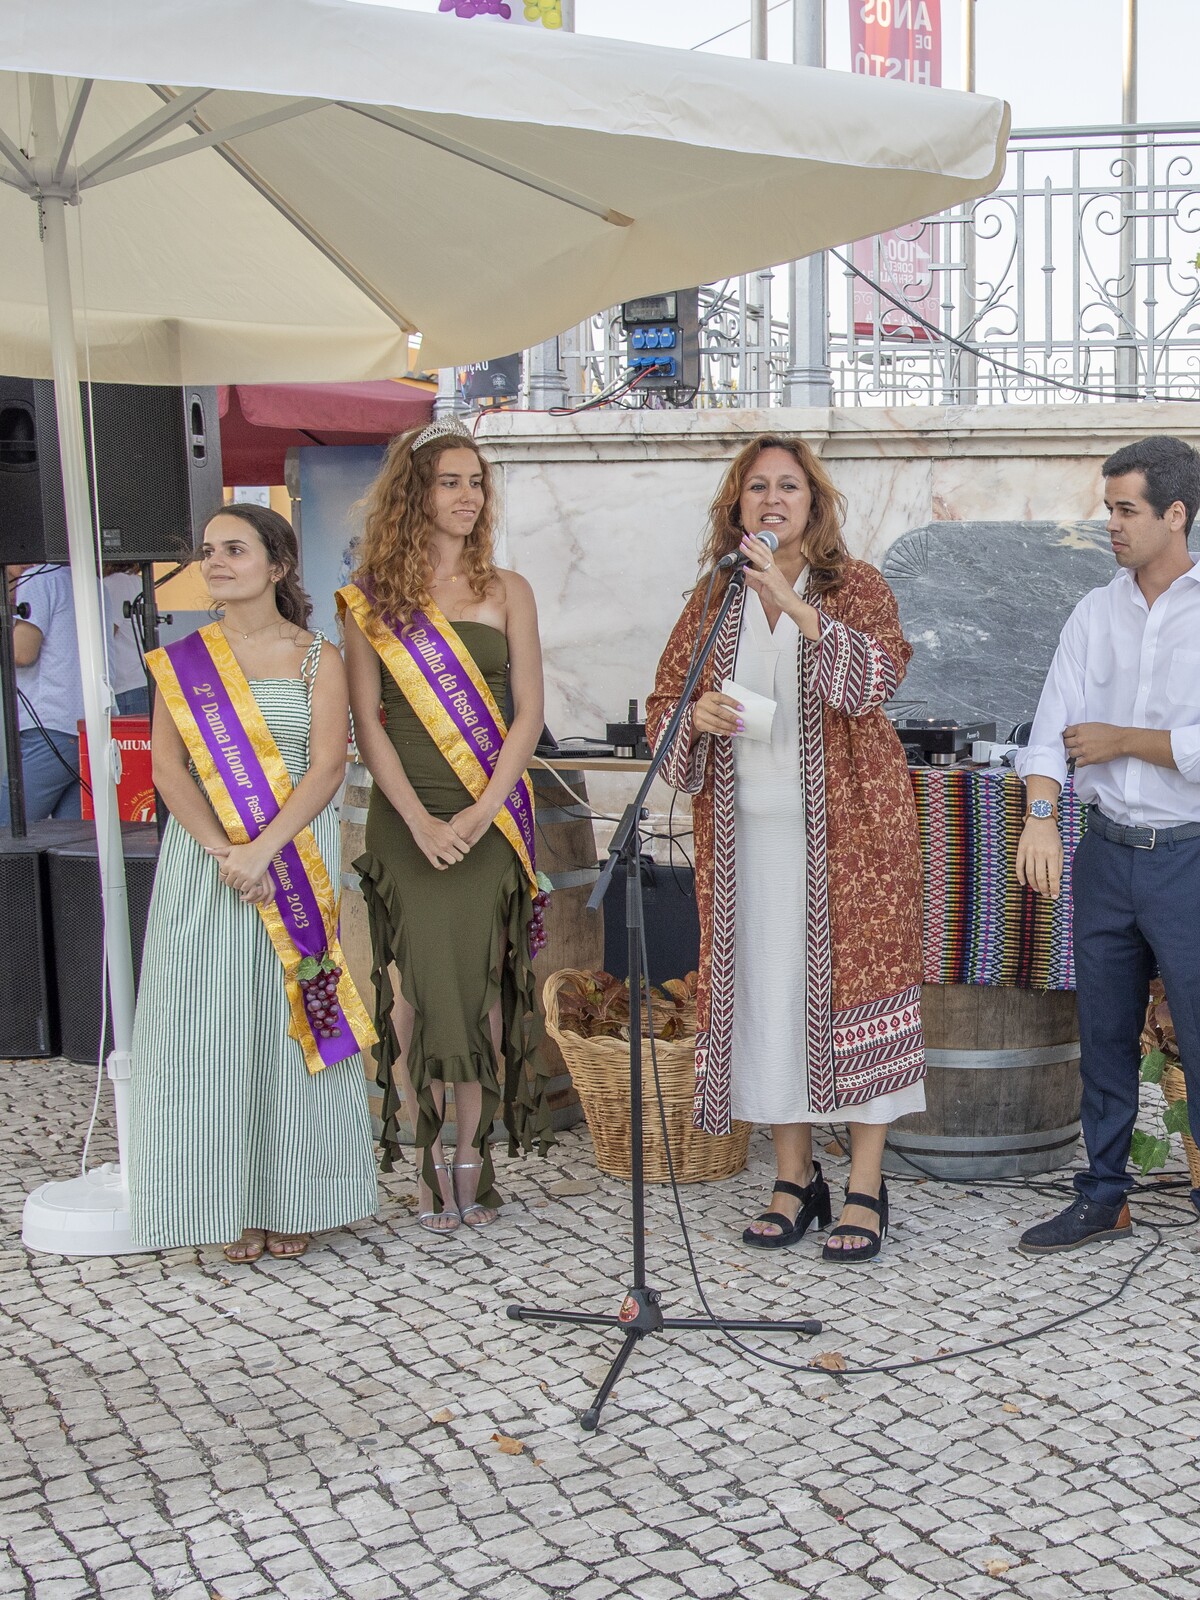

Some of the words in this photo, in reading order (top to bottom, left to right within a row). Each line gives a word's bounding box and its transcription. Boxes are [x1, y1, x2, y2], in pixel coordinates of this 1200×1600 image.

[408, 628, 445, 675] Rainha
[437, 671, 458, 693] da
[448, 688, 479, 728] Festa
[471, 725, 494, 752] das
[201, 702, 231, 744] Dama
[221, 744, 253, 789] Honor
[245, 795, 266, 824] Festa
[287, 893, 310, 928] 2023
